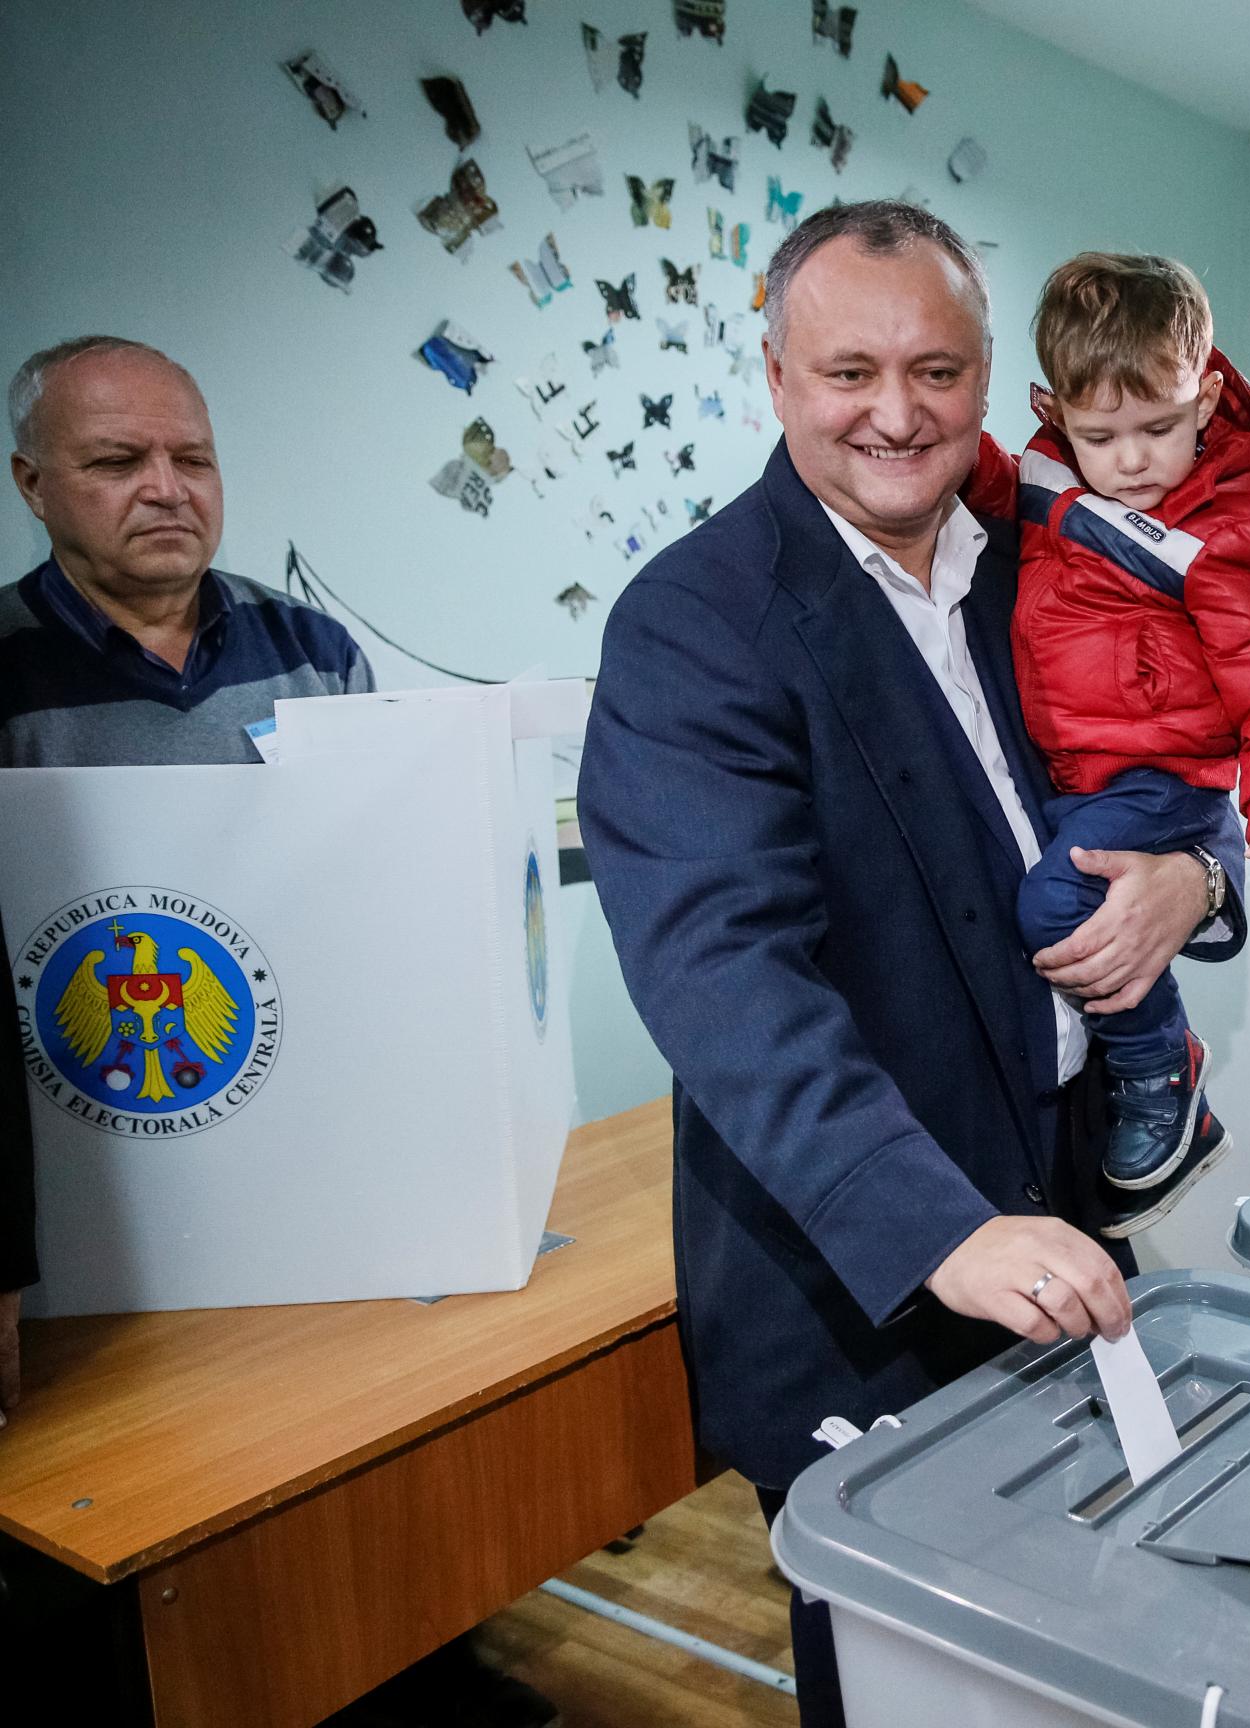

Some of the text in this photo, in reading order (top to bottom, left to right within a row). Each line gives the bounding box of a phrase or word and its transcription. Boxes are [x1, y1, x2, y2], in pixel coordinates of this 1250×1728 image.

[1127, 512, 1163, 542] BIMBUS
[25, 893, 250, 967] REPUBLICA MOLDOVA
[16, 998, 278, 1134] COMISIA ELECTORALĂ CENTRALĂ
